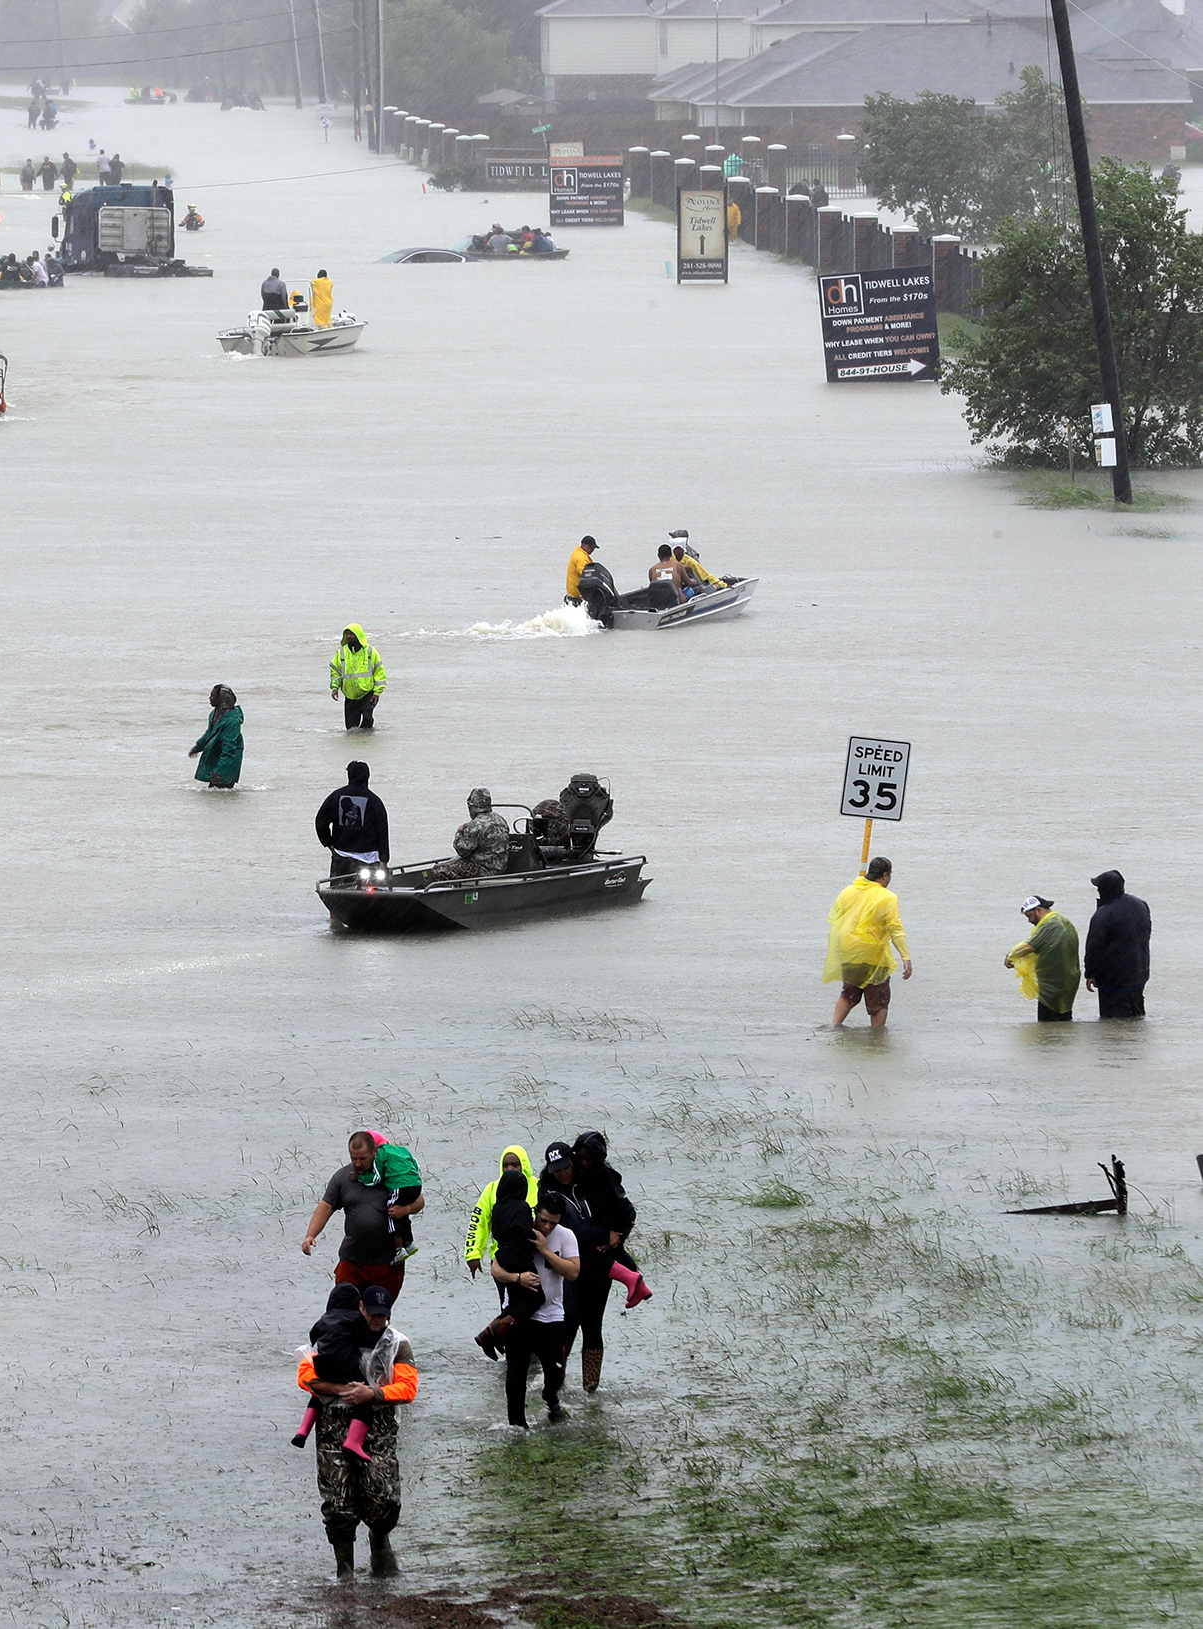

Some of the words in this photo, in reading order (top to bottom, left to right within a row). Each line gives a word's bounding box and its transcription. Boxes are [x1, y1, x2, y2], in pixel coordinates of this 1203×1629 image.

[490, 166, 534, 176] TIDWELL
[555, 170, 573, 186] dh
[864, 280, 900, 289] TIDWELL
[902, 276, 930, 286] LAKES
[827, 279, 857, 304] dh
[903, 292, 928, 301] $170s
[828, 306, 858, 314] Homes
[854, 316, 883, 325] PAYMENT
[884, 313, 924, 321] ASSISTANCE
[846, 324, 883, 333] PROGRAMS
[894, 347, 929, 355] WELCOME!
[840, 364, 908, 376] 844-91-HOUSE
[855, 746, 903, 762] SPEED
[858, 763, 895, 777] LIMIT
[848, 780, 897, 811] 35
[548, 1149, 560, 1158] IVY
